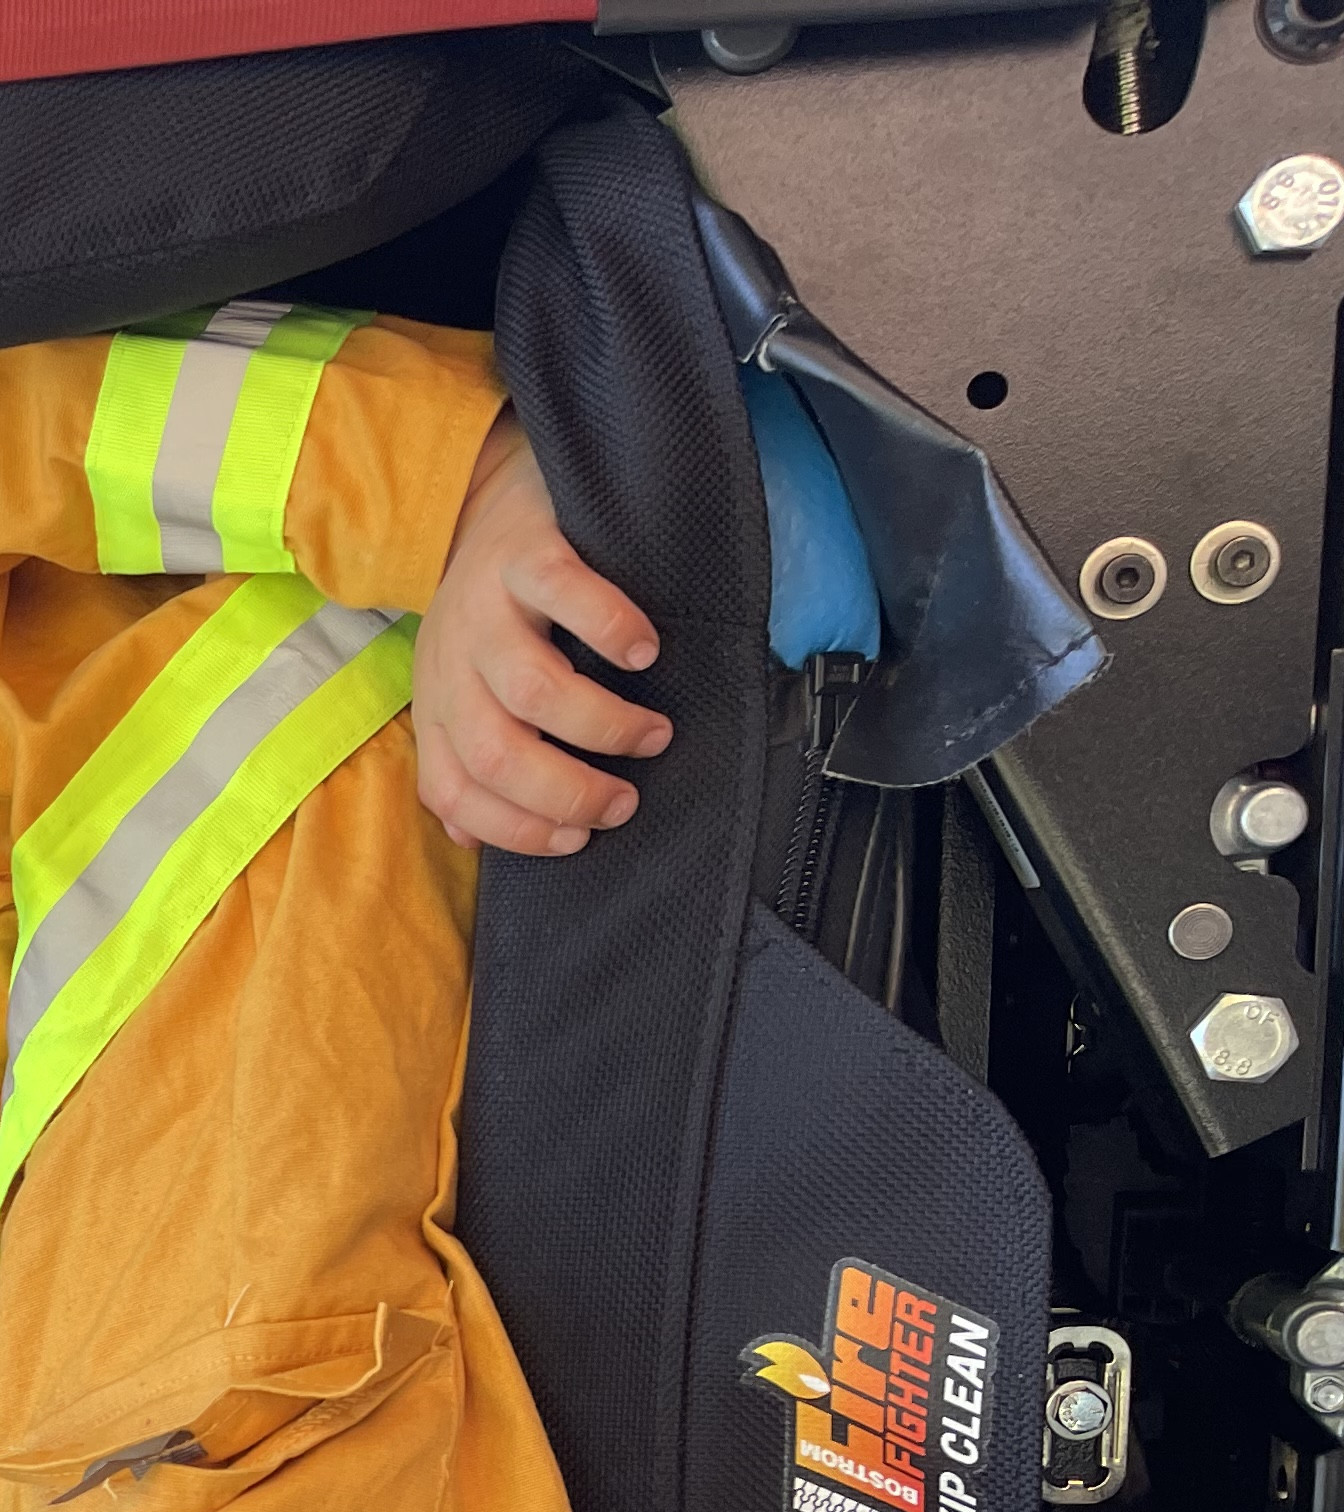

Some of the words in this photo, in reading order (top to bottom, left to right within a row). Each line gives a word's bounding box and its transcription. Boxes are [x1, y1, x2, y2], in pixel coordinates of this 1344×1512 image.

[884, 1290, 938, 1480] FIGHTER
[941, 1313, 990, 1466] CLEAN
[799, 1438, 918, 1506] BOSTROM
